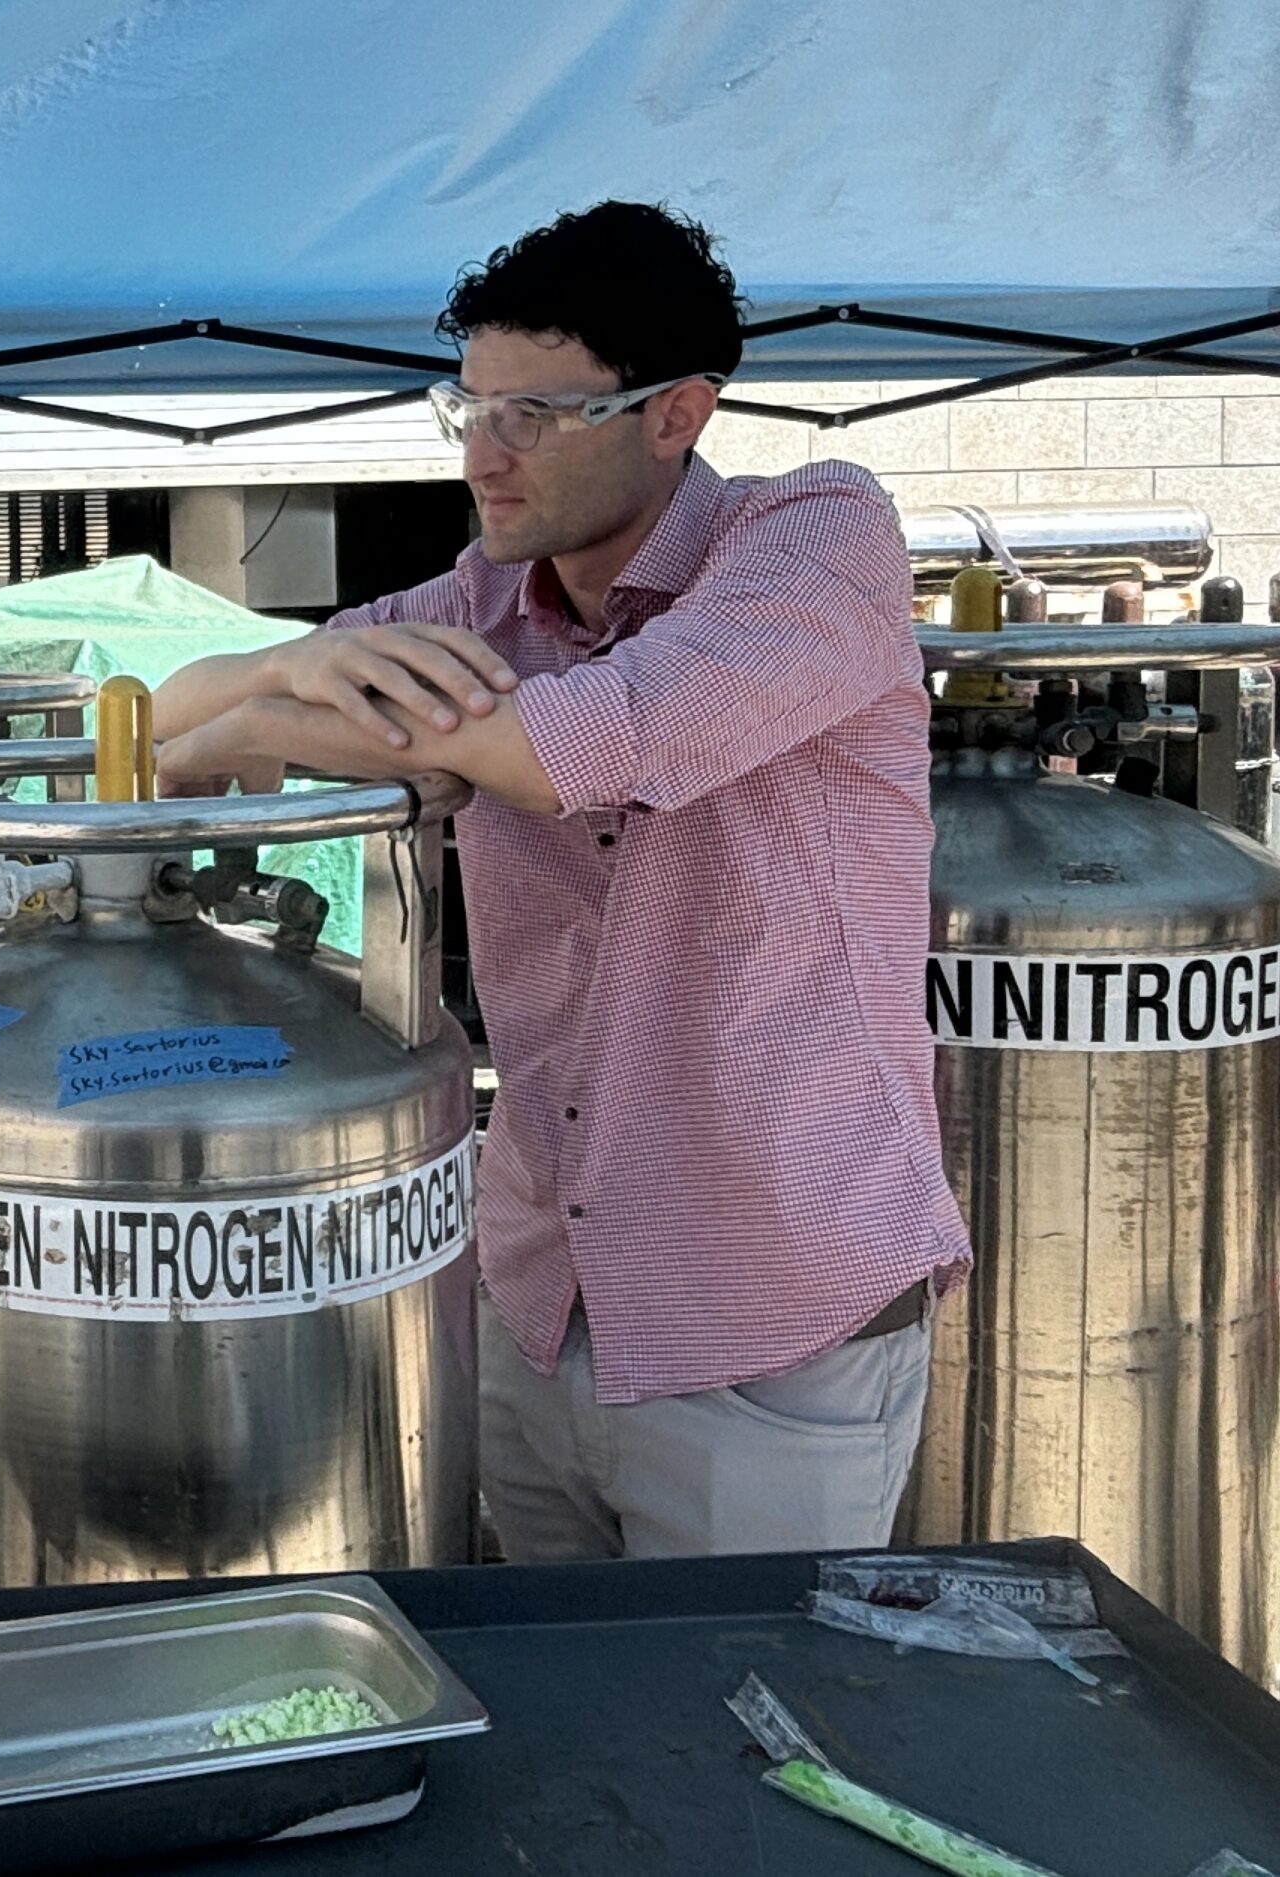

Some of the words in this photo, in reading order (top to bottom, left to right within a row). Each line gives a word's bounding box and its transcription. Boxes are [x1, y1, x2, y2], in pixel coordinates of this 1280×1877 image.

[992, 950, 1280, 1043] NITROGE
[73, 1203, 314, 1300] NITROGEN
[328, 1150, 466, 1285] NITROGEN
